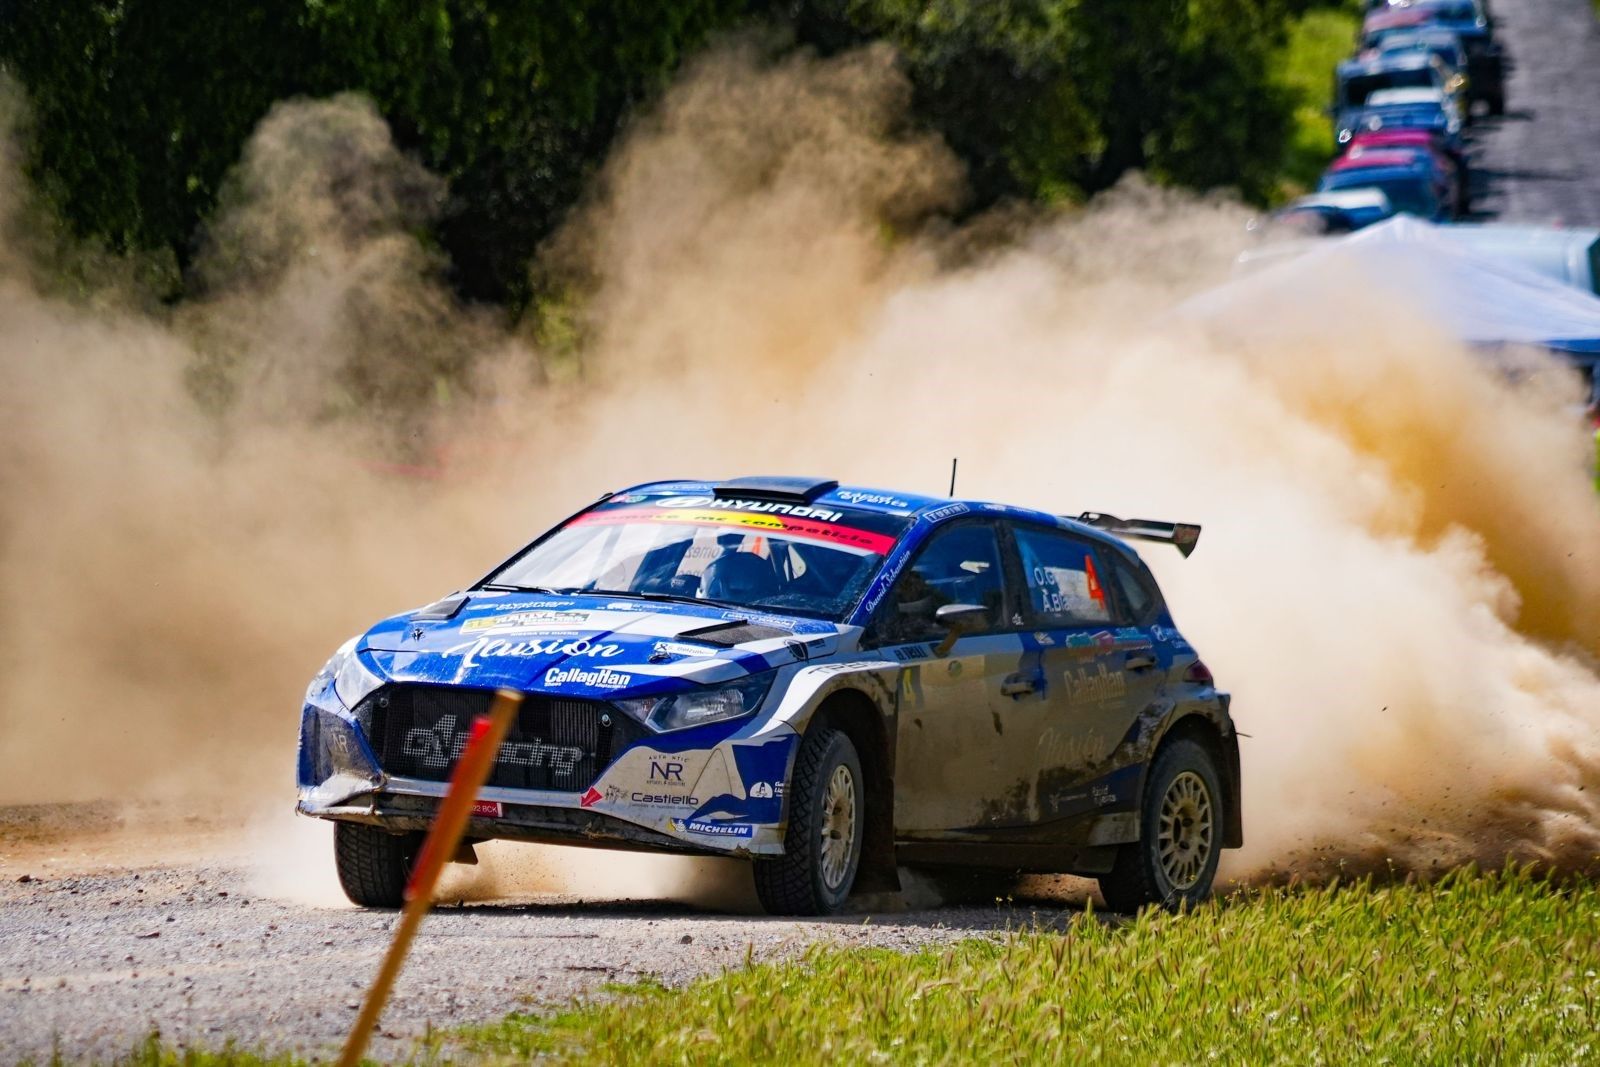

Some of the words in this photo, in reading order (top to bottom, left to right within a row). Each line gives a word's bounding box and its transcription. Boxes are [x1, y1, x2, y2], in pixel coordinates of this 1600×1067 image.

[710, 498, 844, 522] HYUNDAI
[650, 761, 684, 781] NR
[632, 792, 699, 806] Castiello
[689, 822, 749, 834] MICHELIN
